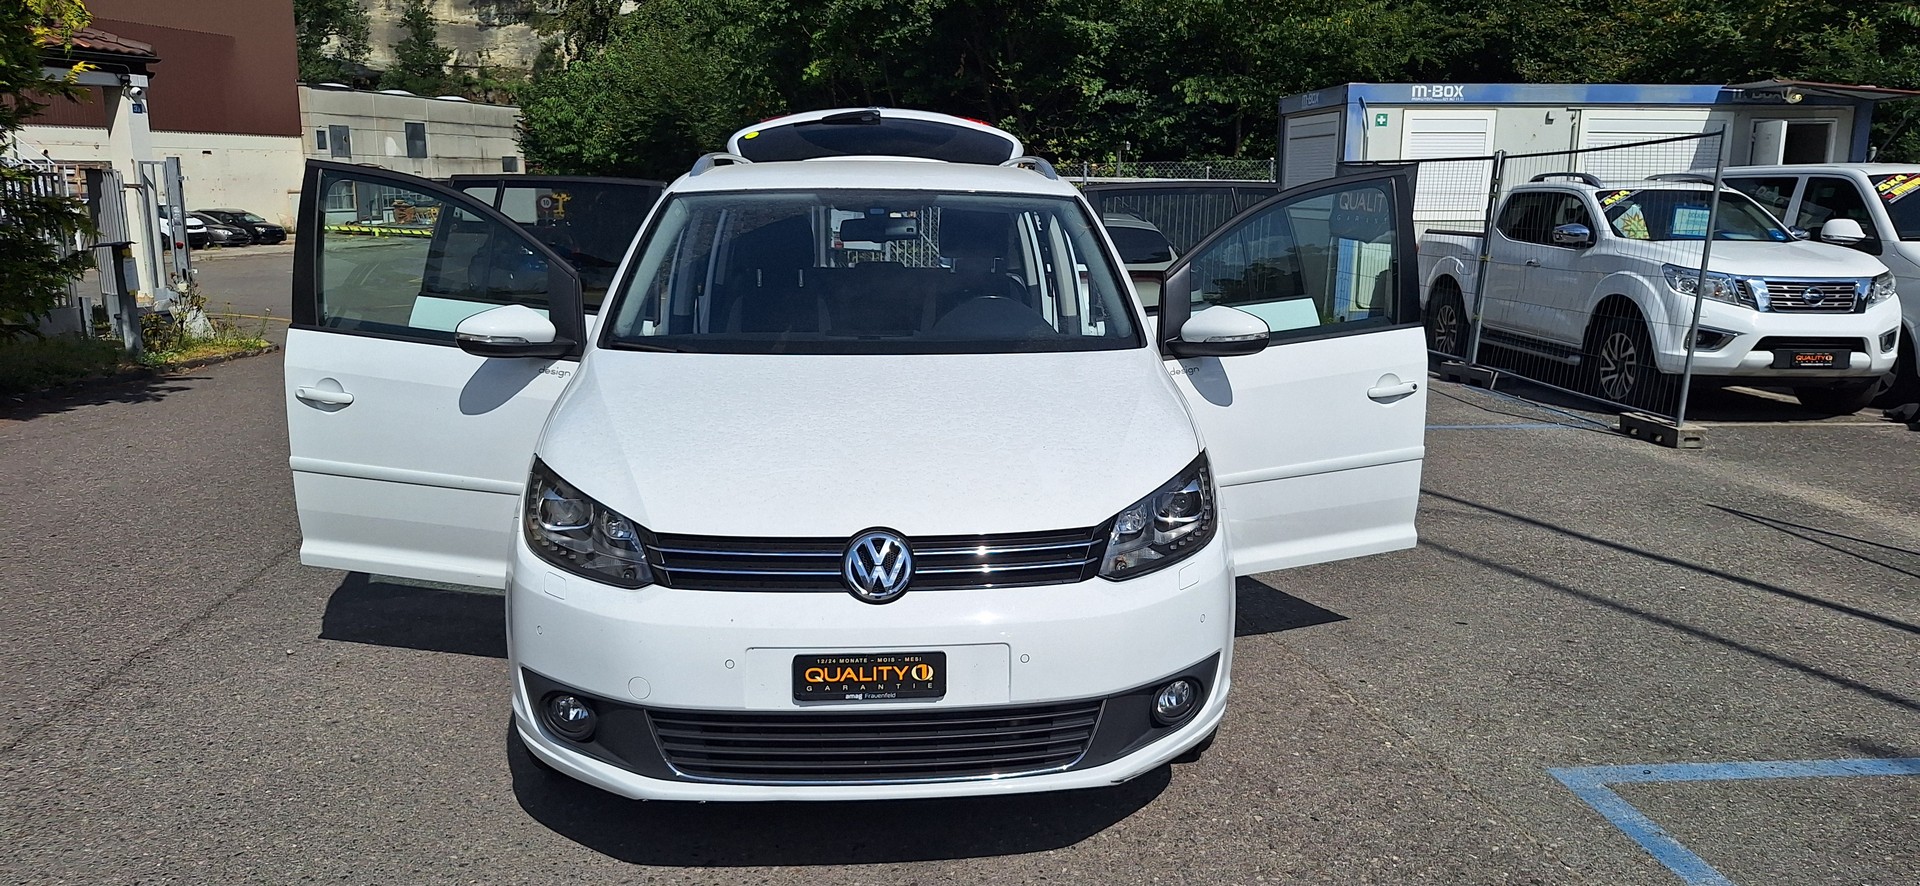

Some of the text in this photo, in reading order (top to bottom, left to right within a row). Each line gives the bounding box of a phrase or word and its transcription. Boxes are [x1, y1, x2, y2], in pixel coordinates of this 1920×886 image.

[1340, 192, 1389, 213] QUALIT
[538, 365, 571, 378] design
[1169, 365, 1200, 376] design
[804, 665, 910, 683] QUALITY
